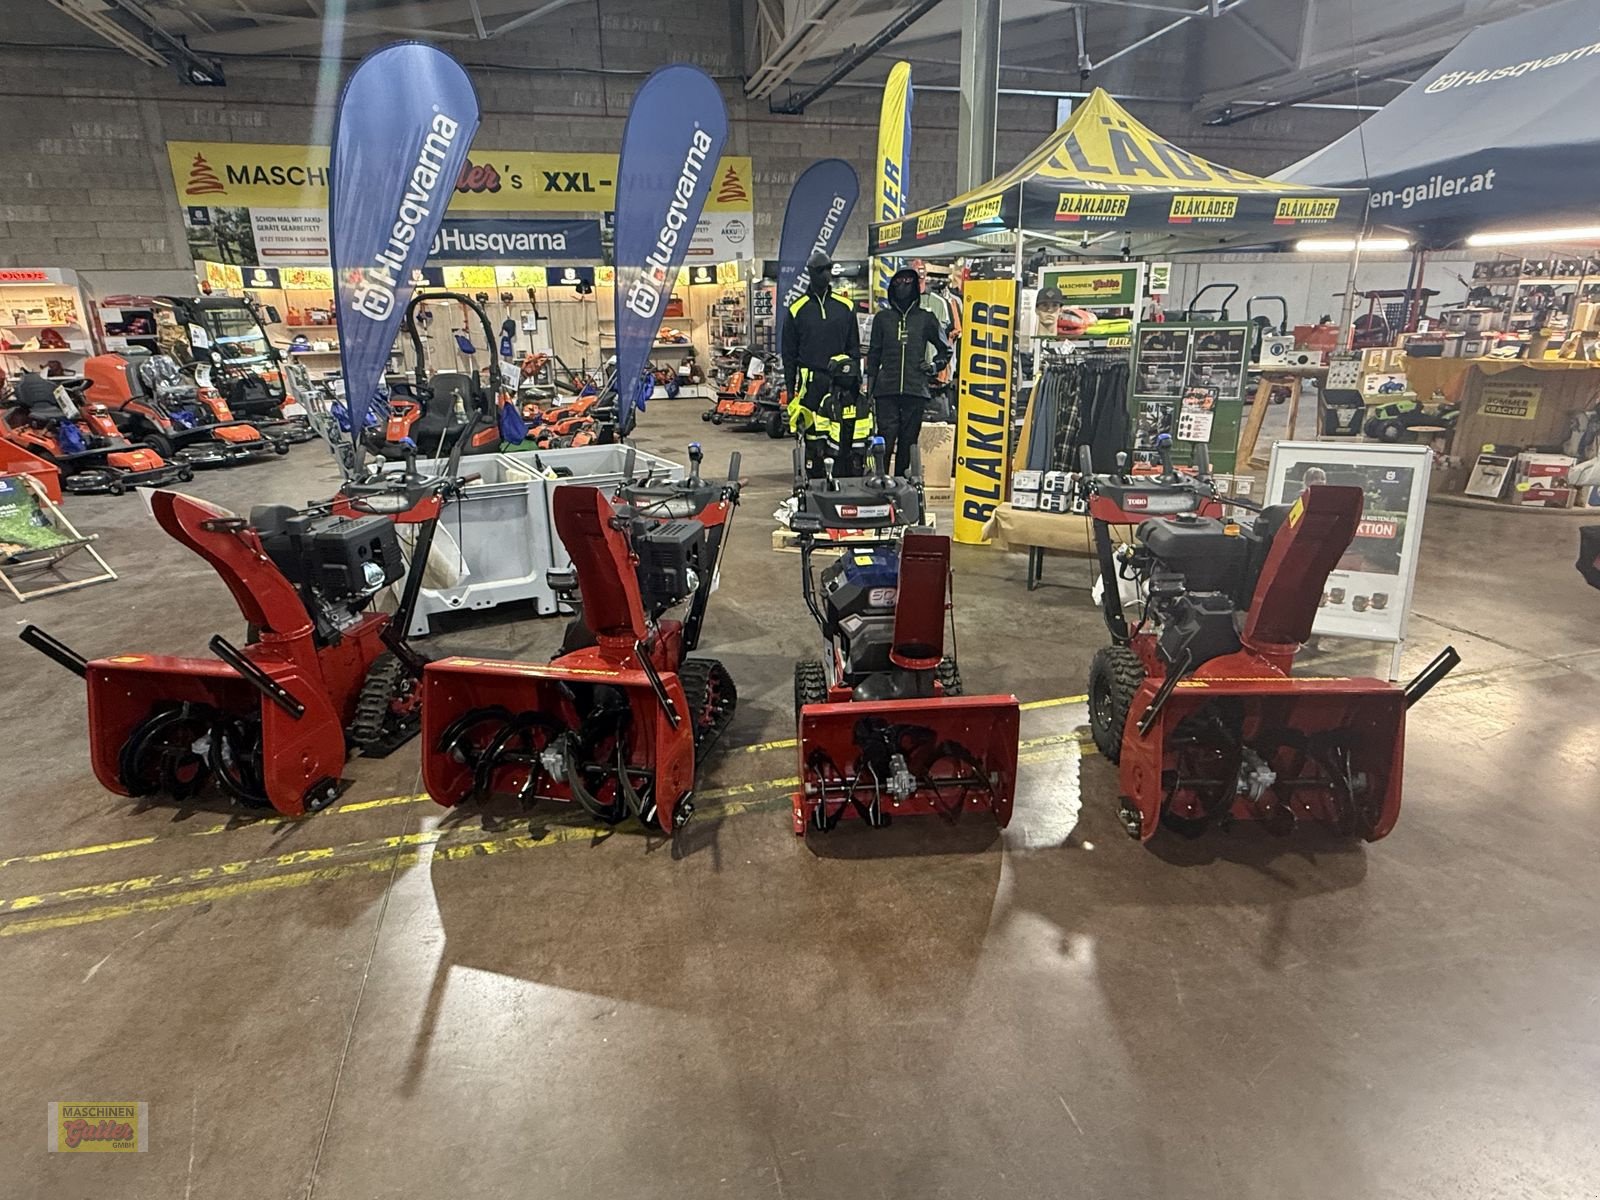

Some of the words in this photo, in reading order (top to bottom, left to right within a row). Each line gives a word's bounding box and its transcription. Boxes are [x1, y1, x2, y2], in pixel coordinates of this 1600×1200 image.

[1453, 42, 1600, 88] Husqvarn
[369, 113, 459, 287] Husqvarna
[640, 129, 712, 286] Husqvarna
[1060, 194, 1126, 214] BLÅKLÄDER
[1173, 197, 1234, 216] BLÅKLÄDER
[1279, 199, 1336, 217] BLÅKLÄDER
[442, 228, 567, 254] Husqvarna
[957, 300, 1010, 523] BLÅKLÄDER
[1127, 497, 1146, 505] TORO
[1356, 522, 1393, 537] KTION
